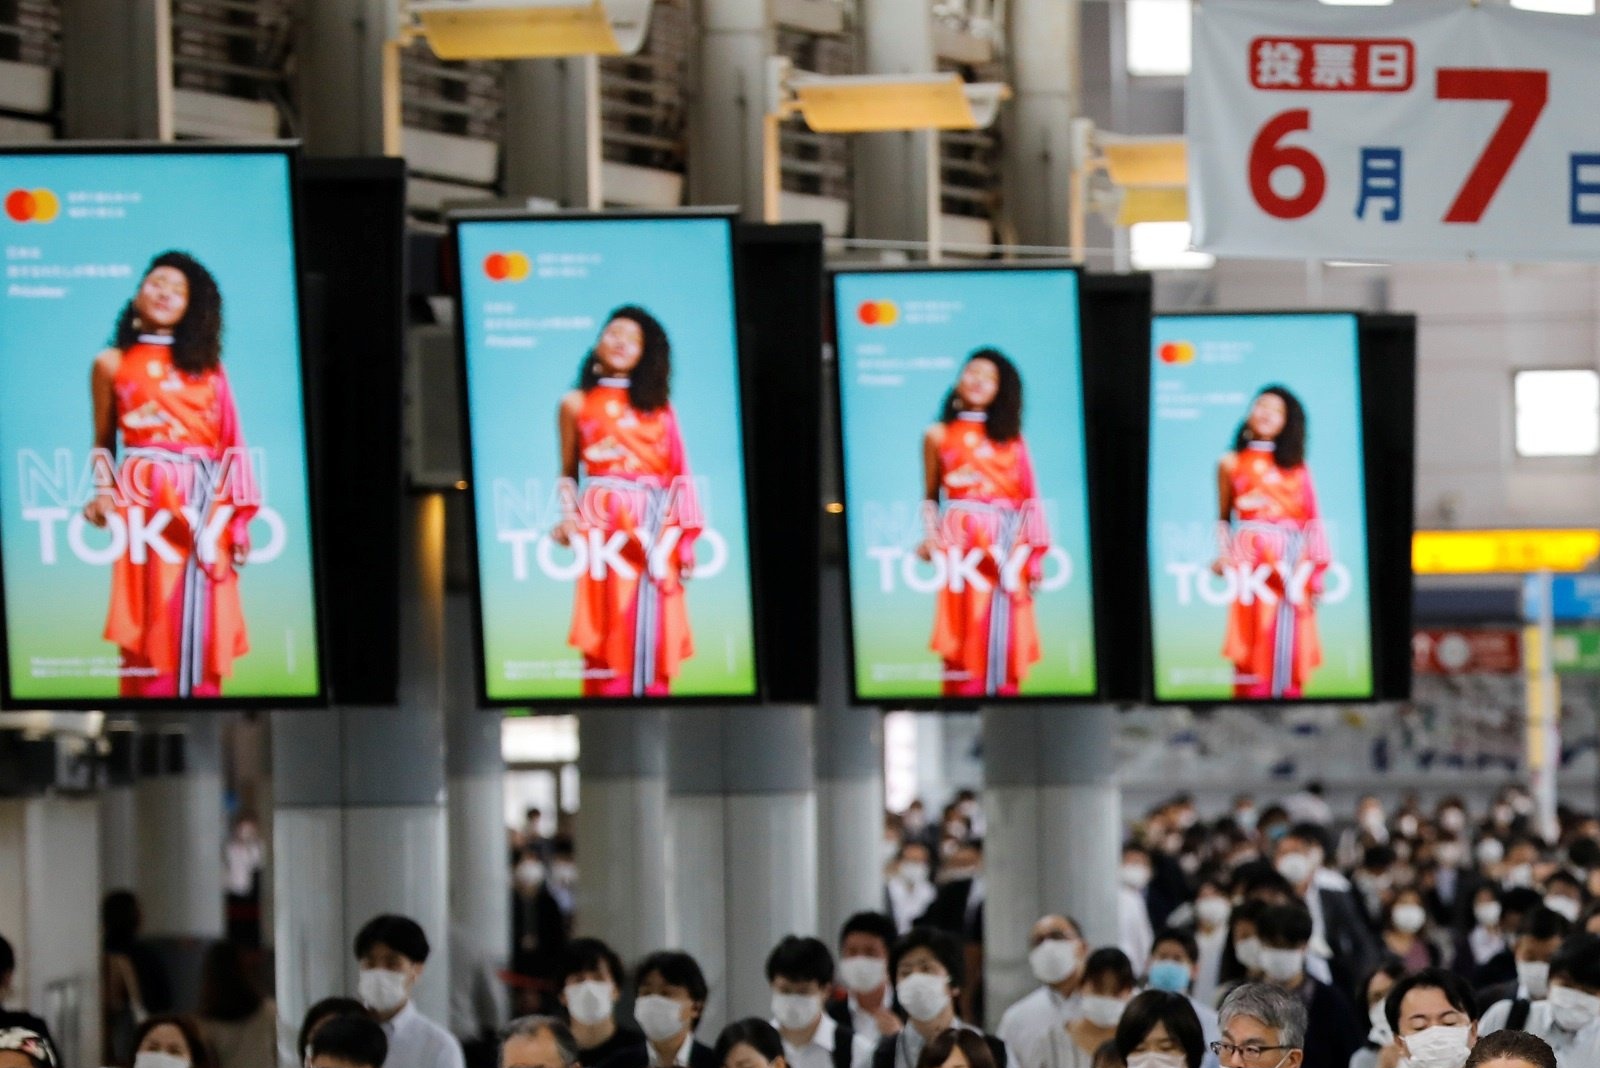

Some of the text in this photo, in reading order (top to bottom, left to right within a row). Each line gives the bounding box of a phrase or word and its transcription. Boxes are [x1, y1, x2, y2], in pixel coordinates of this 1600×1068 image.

[1257, 43, 1409, 87] 投票日
[17, 447, 267, 507] NAOMI
[22, 505, 287, 565] TOKYO
[497, 527, 729, 581] TOKYO
[866, 545, 1073, 593] TOKYO
[1165, 561, 1352, 605] TOKYO
